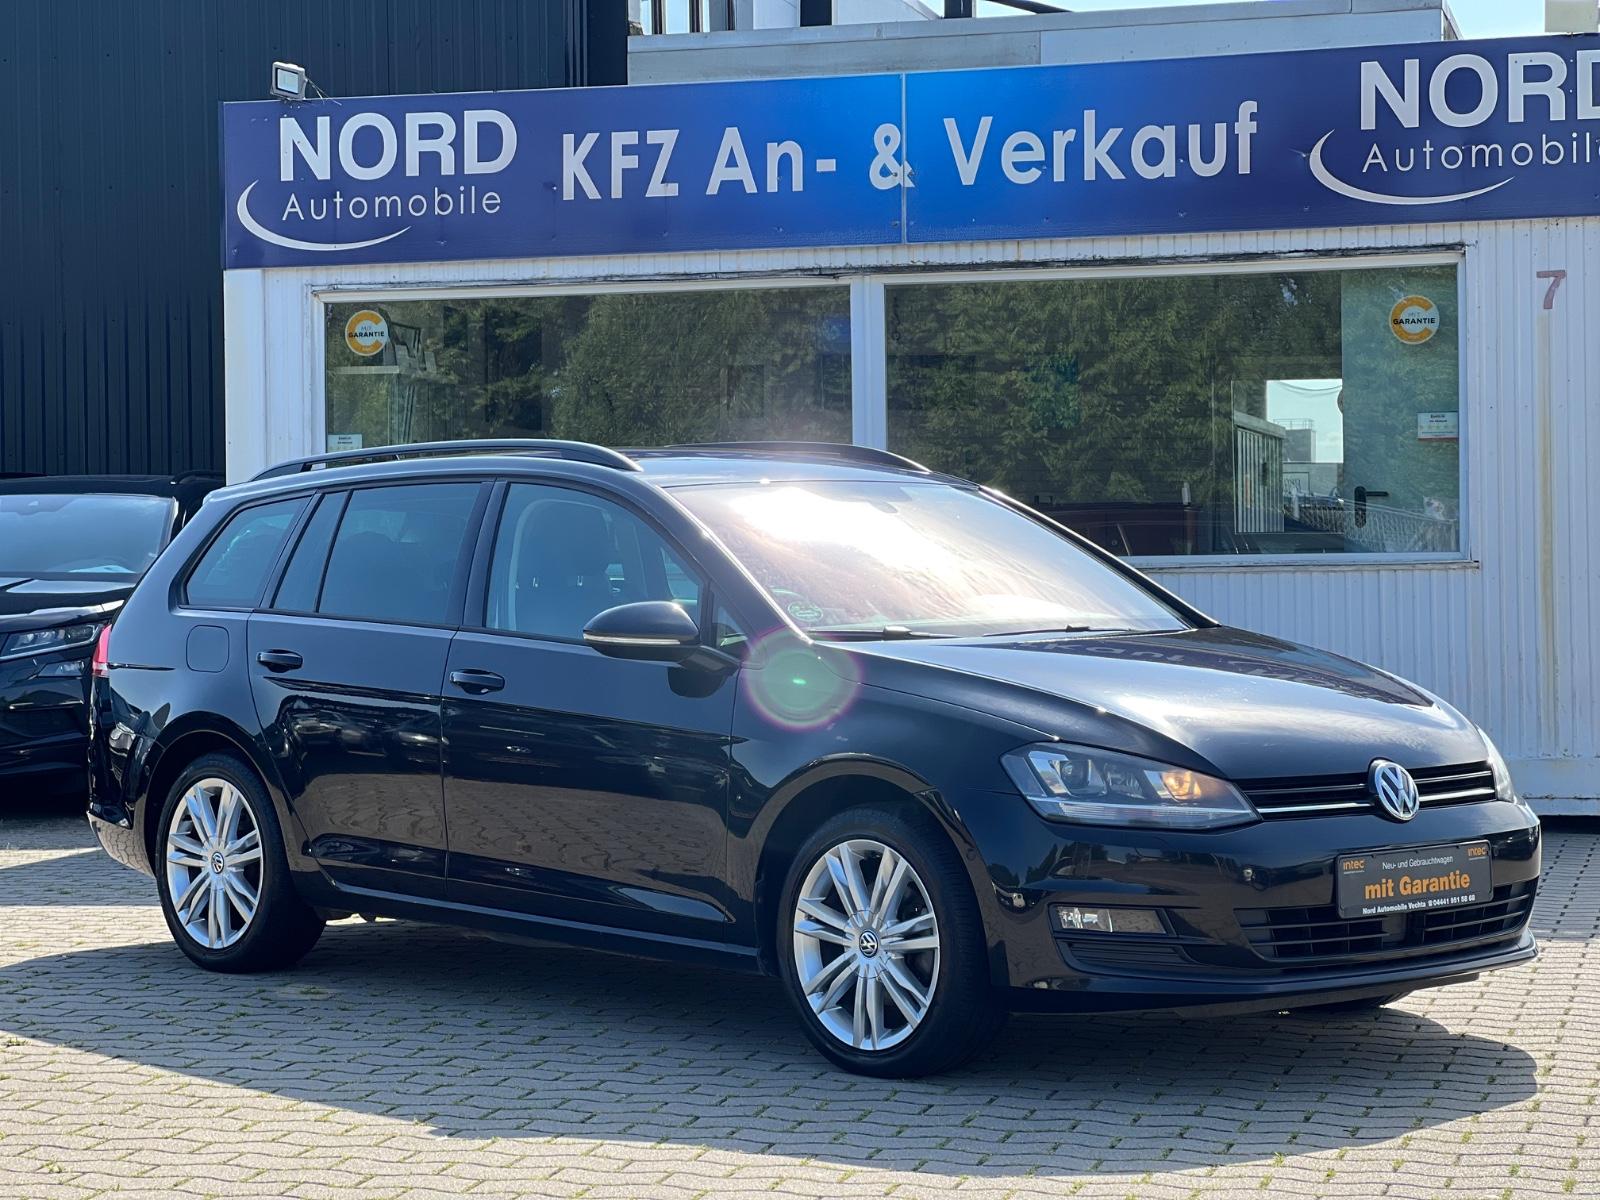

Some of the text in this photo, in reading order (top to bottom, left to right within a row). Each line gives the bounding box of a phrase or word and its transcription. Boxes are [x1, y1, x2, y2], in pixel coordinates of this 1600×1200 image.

[279, 109, 518, 183] NORD
[562, 100, 1259, 201] KFZ An- & Verkauf
[1362, 132, 1600, 173] Automobil
[282, 185, 502, 221] Automobile
[1536, 270, 1566, 310] 7
[348, 330, 385, 338] GARANTIE
[1393, 317, 1436, 325] GARANTIE
[1382, 856, 1453, 870] Neu- und Gebrauchtwagen
[1365, 870, 1470, 899] mit Garantie
[1362, 907, 1376, 915] Nord
[1377, 903, 1407, 914] Automobile
[1408, 901, 1426, 910] Vechta
